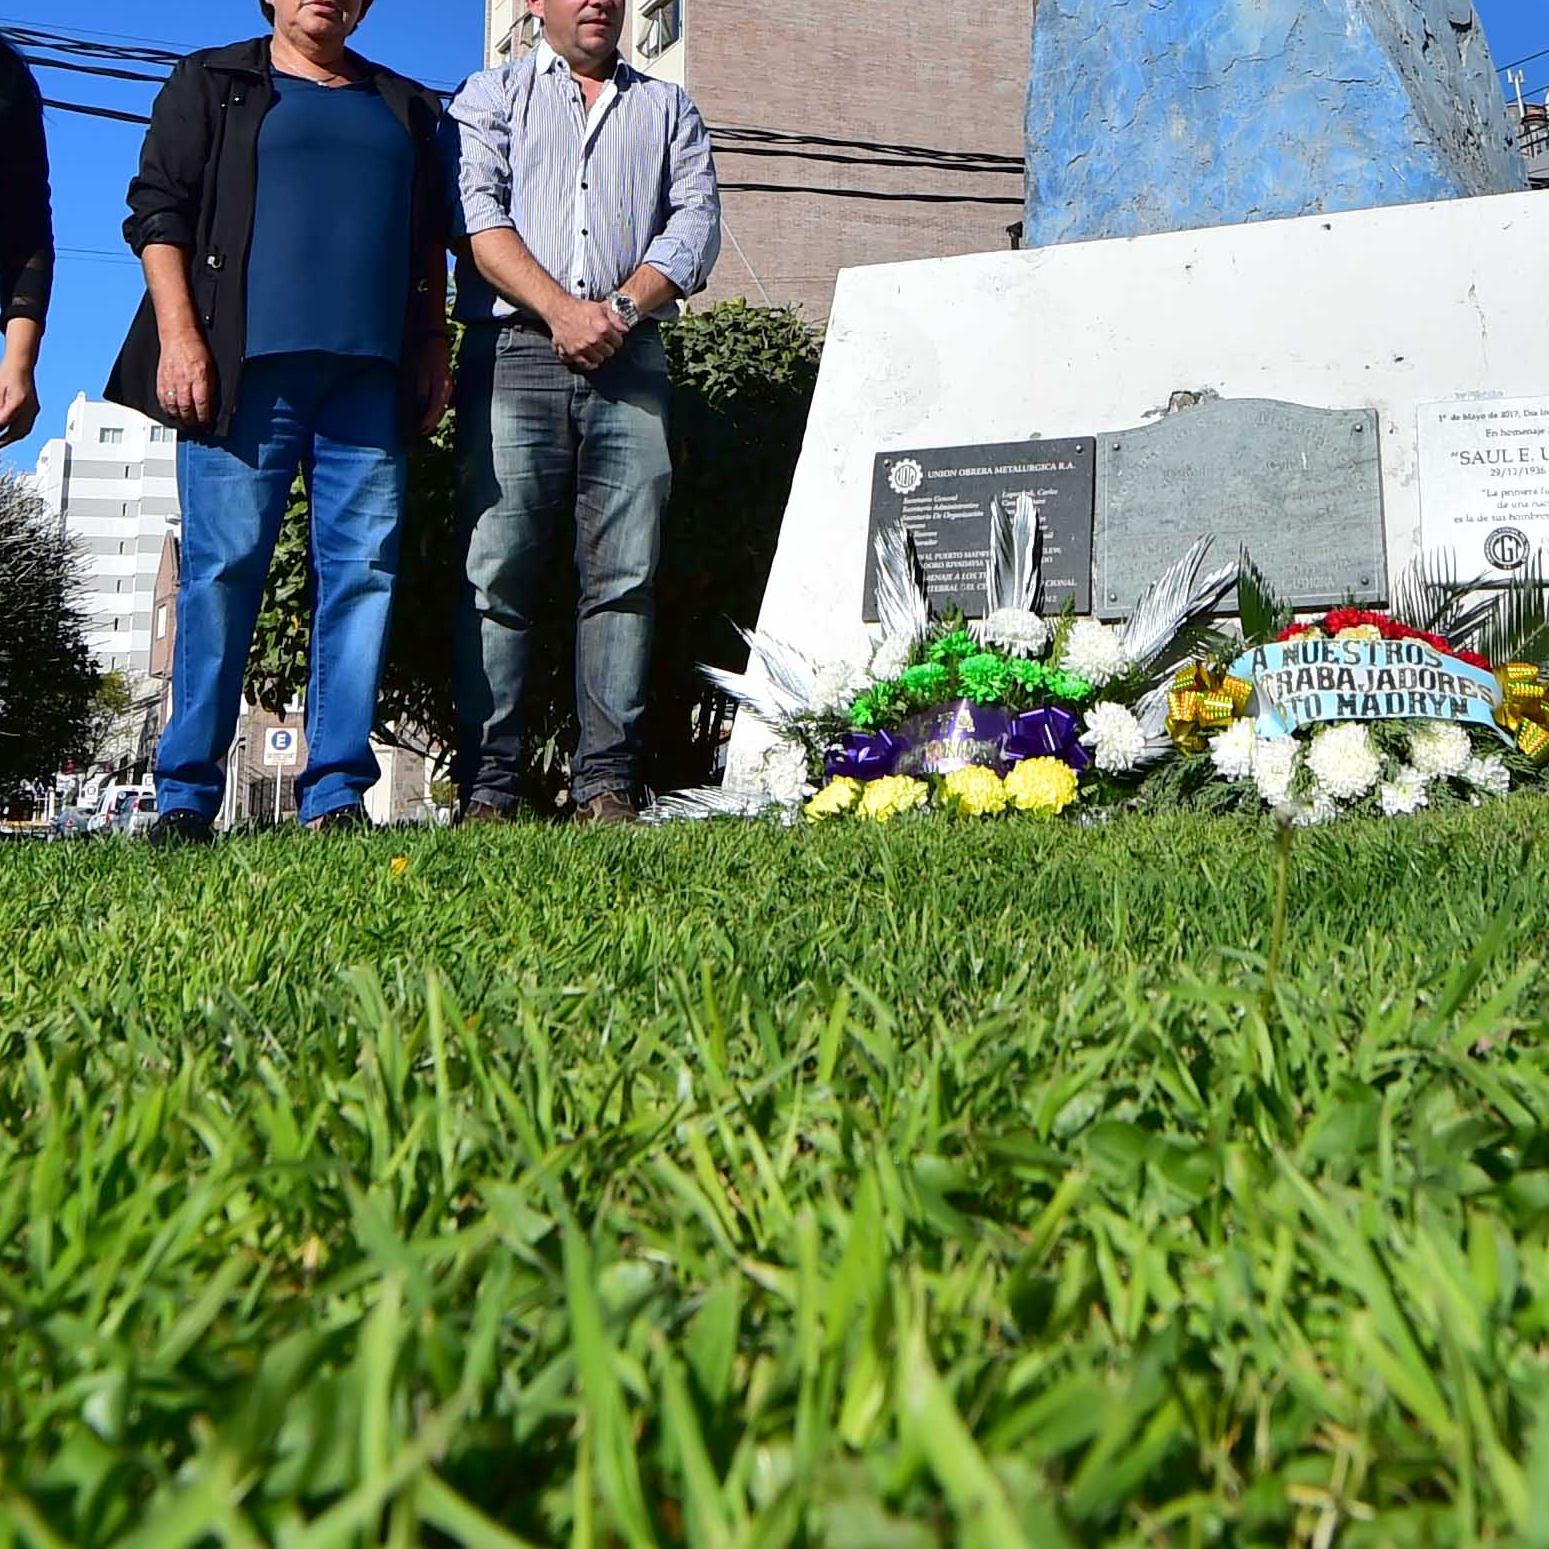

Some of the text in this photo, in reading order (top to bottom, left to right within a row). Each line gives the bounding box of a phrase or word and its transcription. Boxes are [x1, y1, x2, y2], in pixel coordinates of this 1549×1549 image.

[1451, 412, 1460, 420] de
[1462, 412, 1486, 421] Mayo
[1488, 411, 1498, 419] de
[1485, 427, 1498, 438] En
[1500, 427, 1545, 437] homenaje
[1519, 447, 1534, 462] E.
[928, 469, 956, 479] UNION
[958, 467, 994, 477] OBRERA
[994, 463, 1056, 475] METALURGICA
[1501, 488, 1538, 500] primera
[1497, 499, 1508, 509] de
[1511, 501, 1529, 509] una
[1466, 513, 1474, 522] la
[1477, 513, 1489, 522] de
[1508, 511, 1549, 521] hombres
[1252, 639, 1444, 672] A NUESTROS
[1260, 666, 1495, 704] TRABAJADORES
[1337, 691, 1470, 718] MADRYN
[275, 733, 287, 748] E
